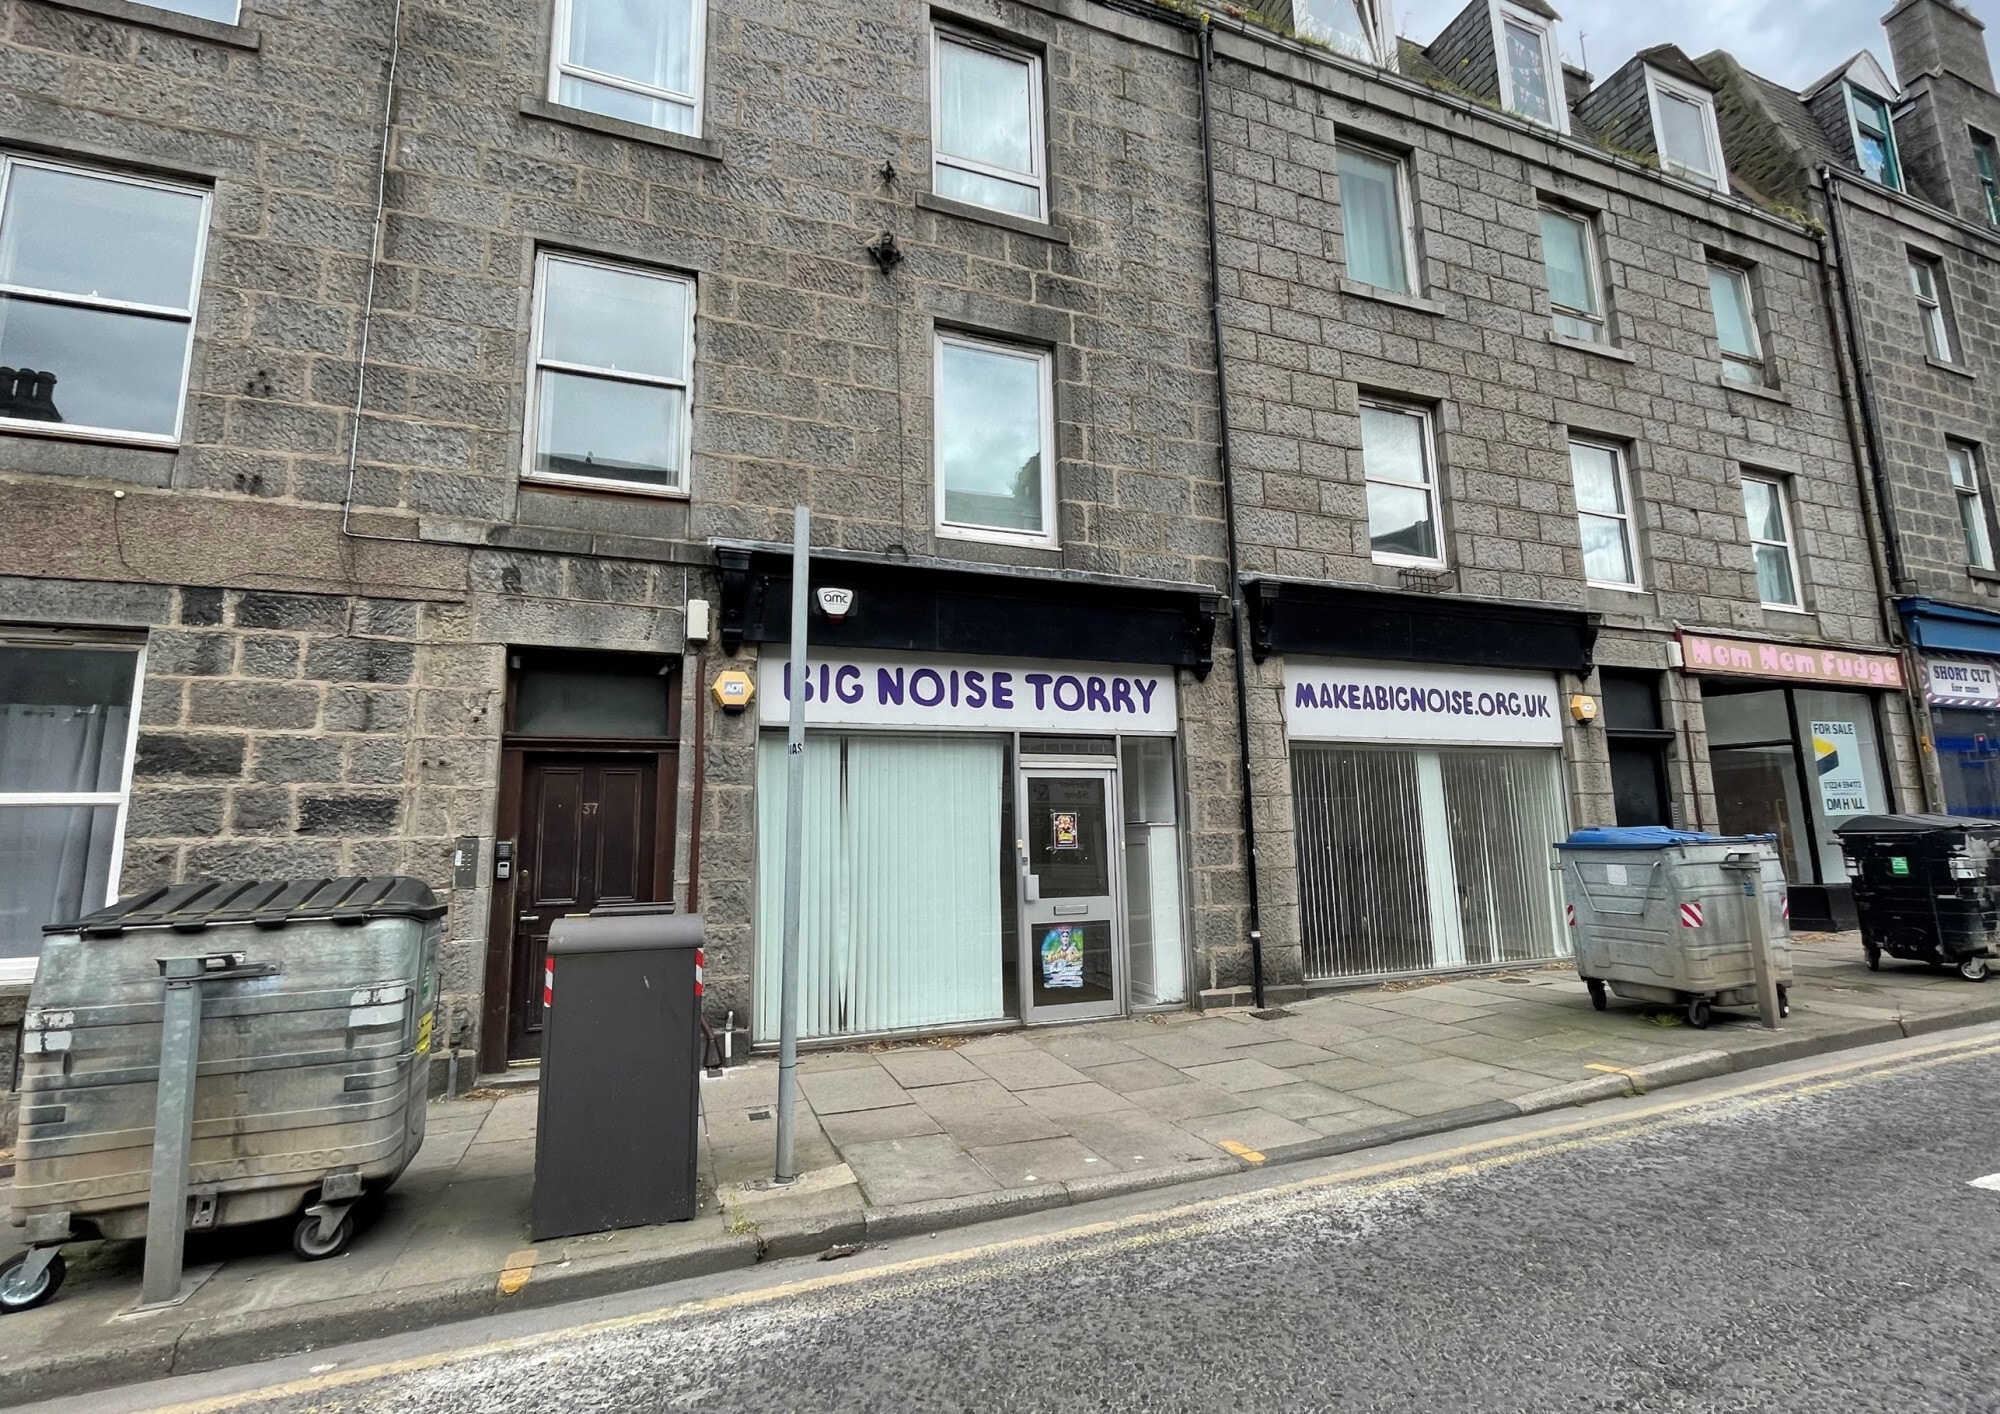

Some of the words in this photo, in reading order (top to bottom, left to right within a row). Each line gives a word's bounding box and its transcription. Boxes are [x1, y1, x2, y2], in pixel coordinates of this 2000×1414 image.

[823, 593, 848, 604] amc
[1691, 638, 1752, 669] Nom
[1759, 645, 1816, 674] Nom
[1821, 651, 1898, 684] Fudge
[1933, 665, 1968, 681] SHORT
[1971, 668, 1991, 683] CUT
[725, 684, 744, 693] ADT
[784, 662, 864, 704] BIG
[877, 667, 1014, 709] NOISE
[1025, 674, 1157, 714] TORRY
[1951, 683, 1963, 692] for
[1965, 686, 1980, 694] men
[1296, 683, 1551, 718] MAKEABIGNOISE.ORG.UK
[1813, 723, 1831, 734] FOR
[1832, 723, 1854, 735] SALE
[582, 802, 599, 815] 37
[1826, 798, 1842, 810] DM
